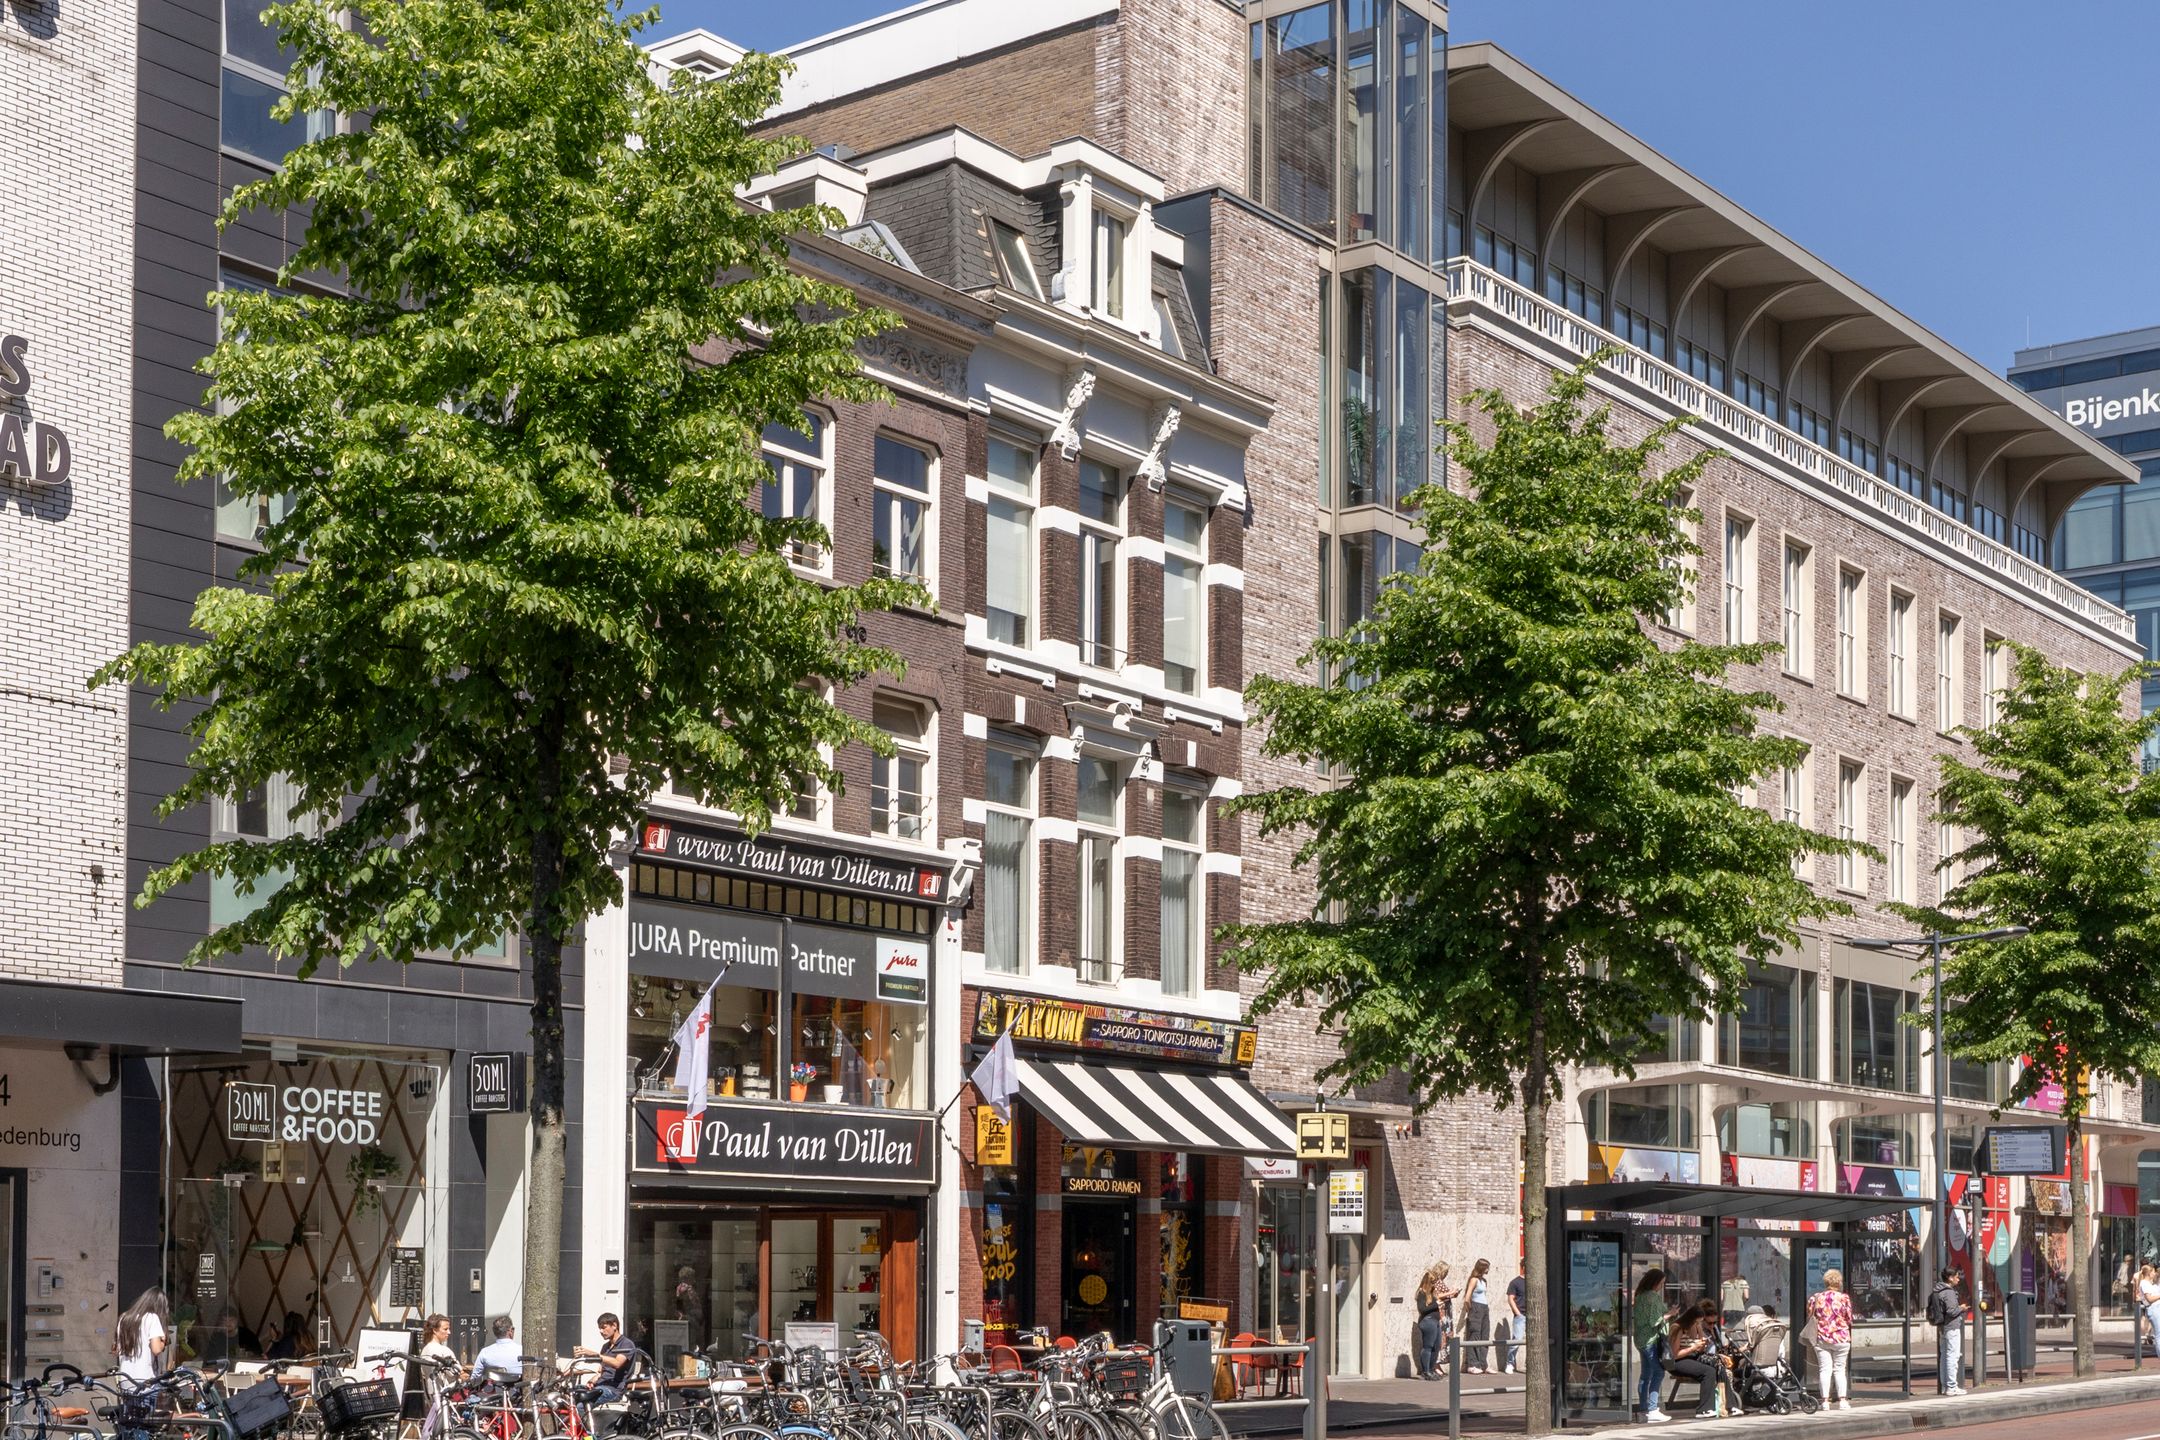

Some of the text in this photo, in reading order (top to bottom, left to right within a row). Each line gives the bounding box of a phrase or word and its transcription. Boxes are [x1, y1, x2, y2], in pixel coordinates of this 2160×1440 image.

[2066, 388, 2160, 429] Bijenk
[789, 852, 825, 878] van
[831, 854, 916, 893] Dillen.nl
[629, 921, 682, 957] JURA
[688, 929, 778, 967] Premium
[885, 948, 918, 971] jura
[1005, 1000, 1085, 1043] TAKUMI
[1099, 1022, 1218, 1050] SAPPORO TONKOTSU RAMEN
[474, 1062, 506, 1092] 30ML
[232, 1089, 271, 1122] 30ML
[282, 1086, 382, 1117] COFFEE
[475, 1094, 488, 1103] COFFEE
[0, 1126, 81, 1152] denburg
[232, 1122, 248, 1132] COFFEE
[281, 1114, 381, 1146] &FOOD.
[704, 1119, 913, 1166] Paul van Dillen
[1069, 1177, 1141, 1194] SAPPORO RAMEN
[1251, 1168, 1284, 1176] VREDENBURG
[1867, 1220, 1886, 1231] neem
[460, 1318, 467, 1326] 23
[471, 1318, 478, 1326] 23
